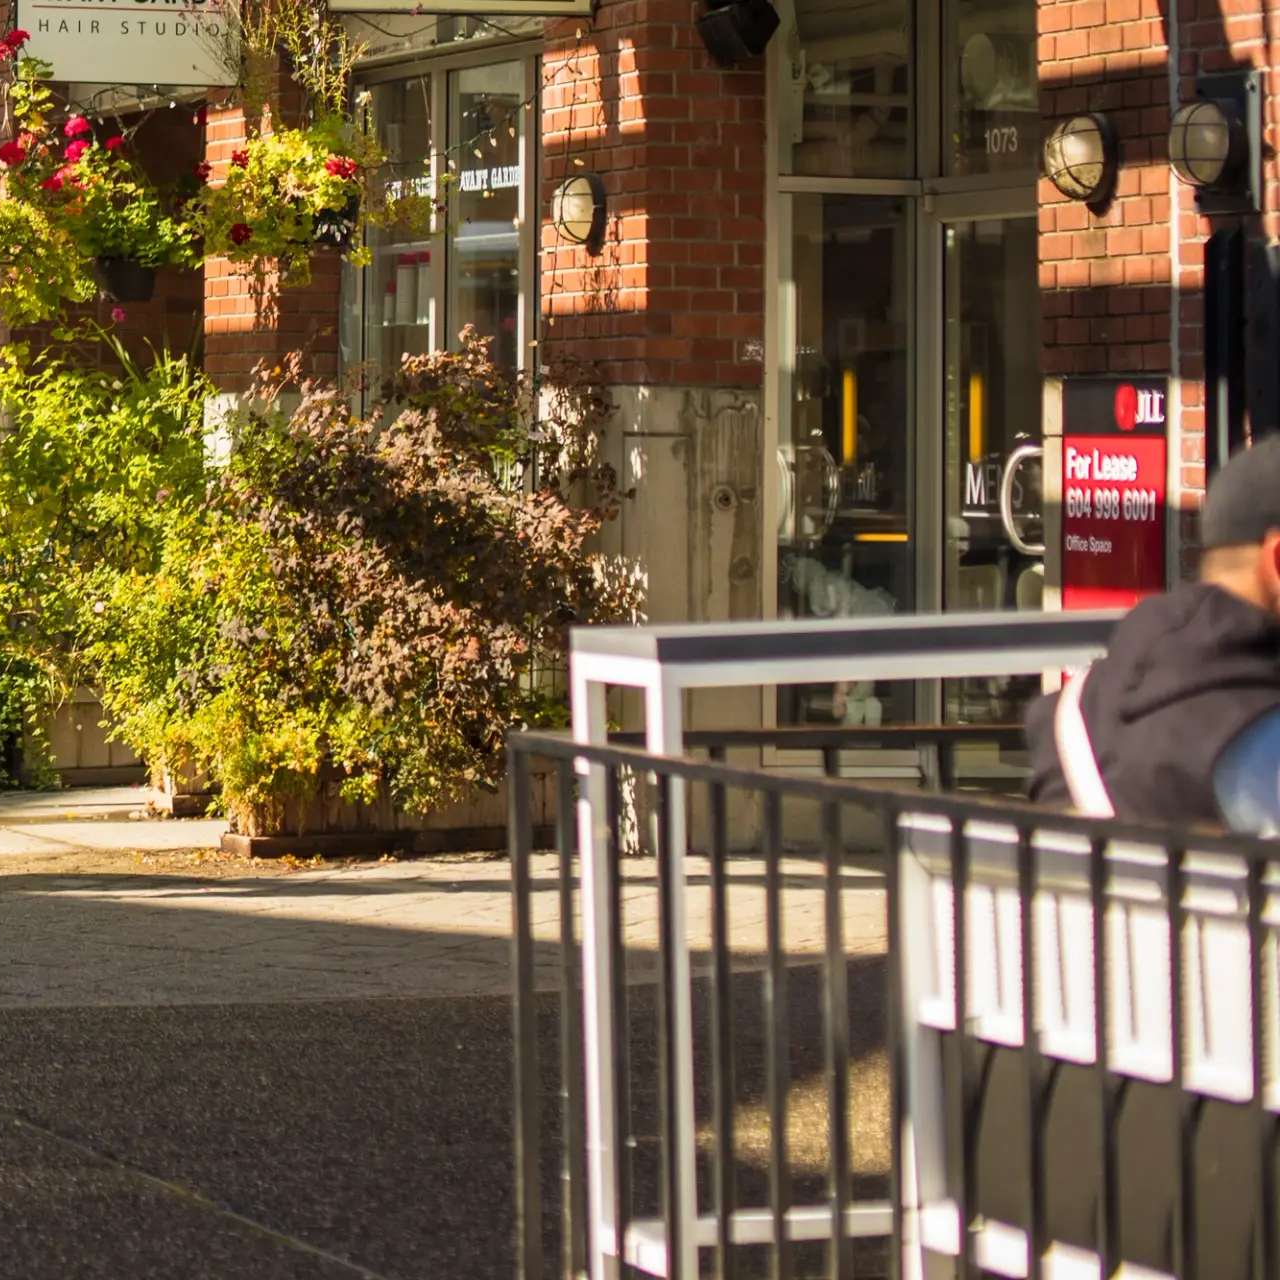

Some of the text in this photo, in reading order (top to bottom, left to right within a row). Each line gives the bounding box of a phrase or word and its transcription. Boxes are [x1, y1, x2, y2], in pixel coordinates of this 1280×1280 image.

[38, 18, 220, 37] HAIR STUDIO
[984, 126, 1018, 154] 1073
[459, 169, 489, 192] AVANT
[1135, 389, 1166, 424] JLL
[1065, 446, 1138, 482] For Lease
[1065, 486, 1157, 521] 604 998 6001
[1066, 534, 1113, 555] Office Space
